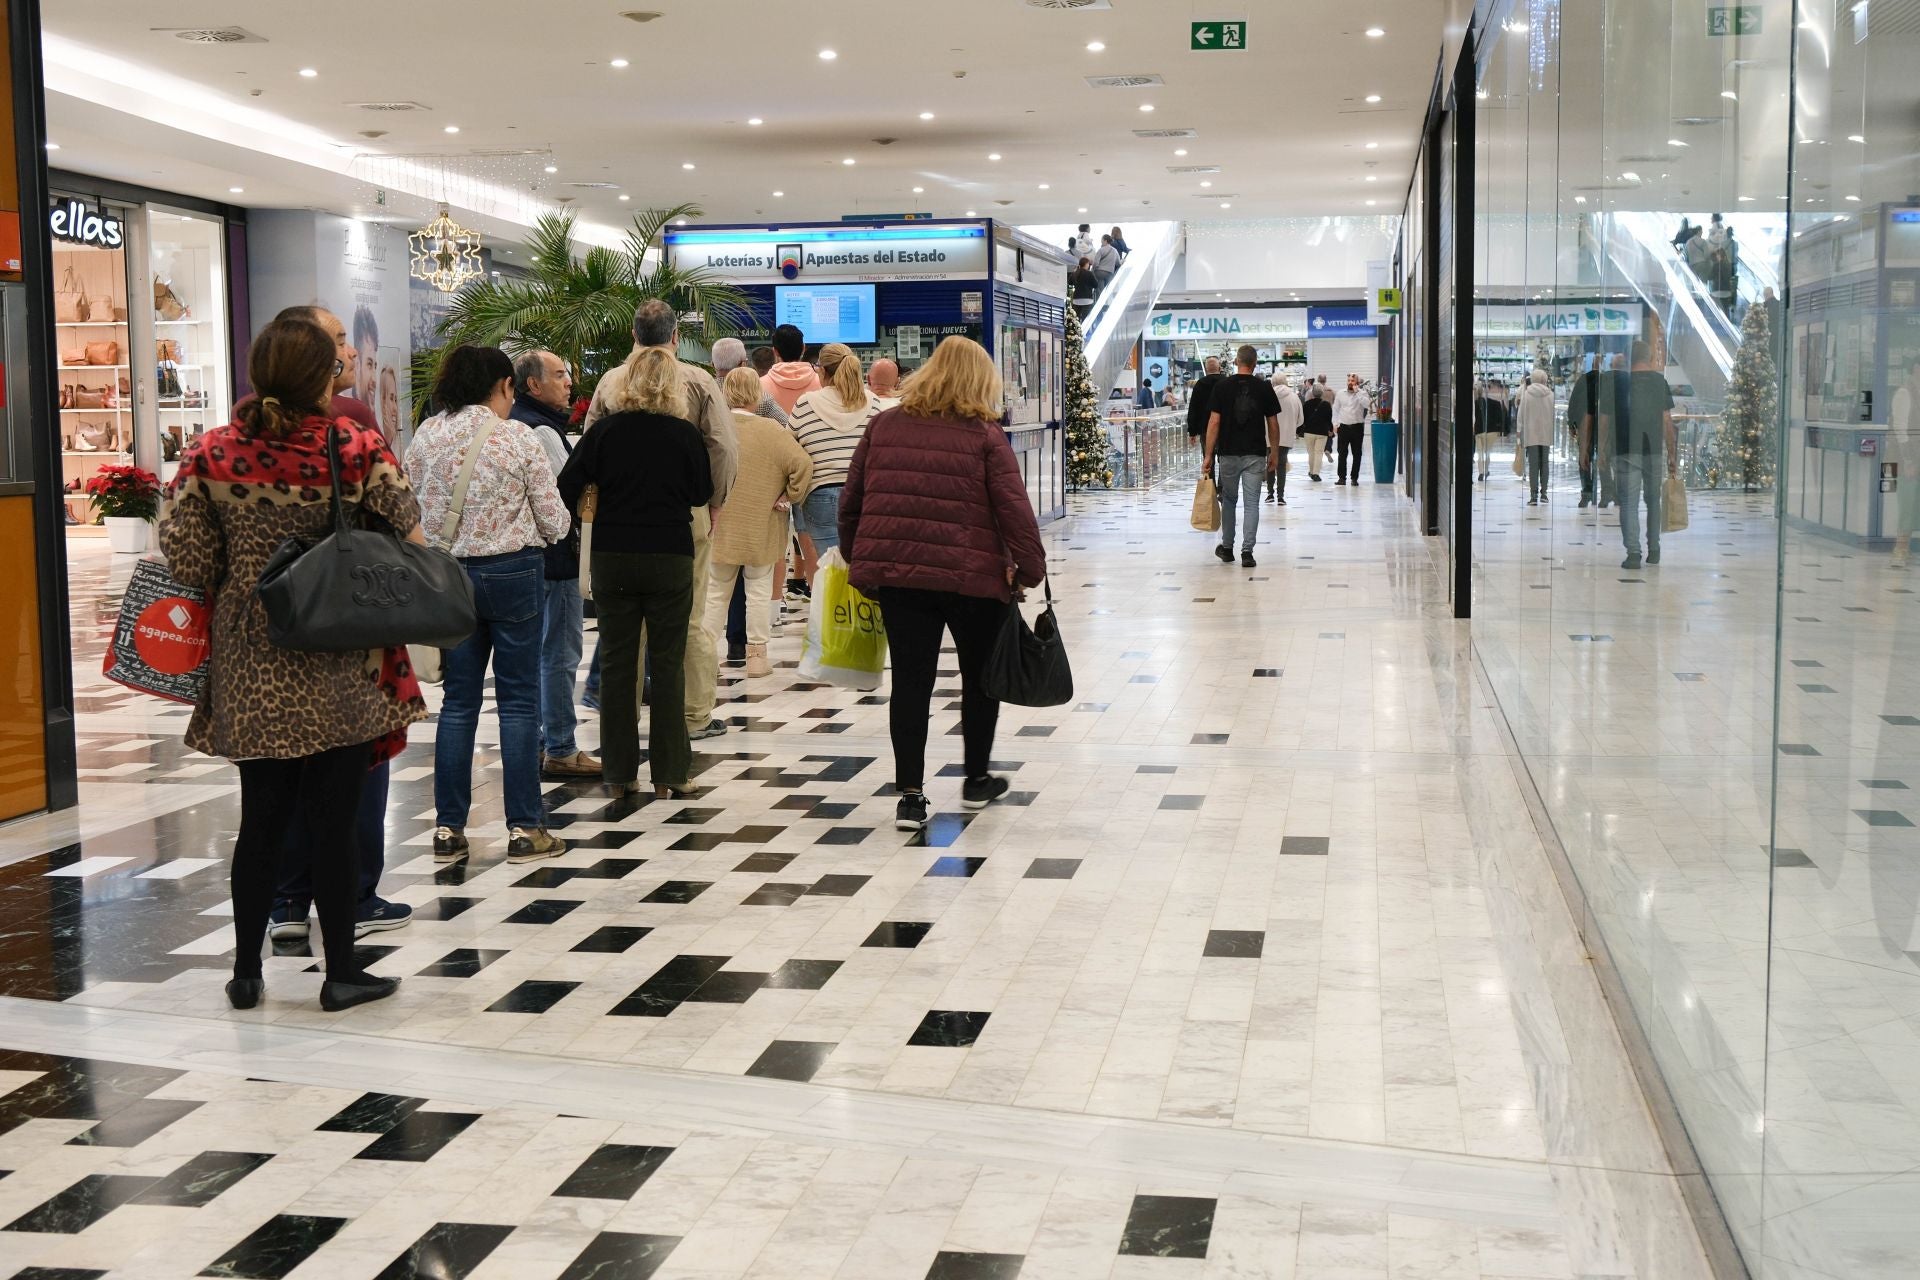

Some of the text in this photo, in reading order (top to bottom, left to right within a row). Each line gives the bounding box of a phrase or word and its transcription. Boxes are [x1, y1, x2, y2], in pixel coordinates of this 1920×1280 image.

[51, 201, 121, 245] ellas
[707, 249, 946, 269] Loterías y Apuestas del Estado
[941, 326, 968, 334] JUEVES
[1178, 318, 1292, 334] FAUNA pet shop
[1328, 318, 1367, 326] VETERINARÍ
[741, 328, 770, 337] SÁBAO
[134, 569, 171, 585] Rimas
